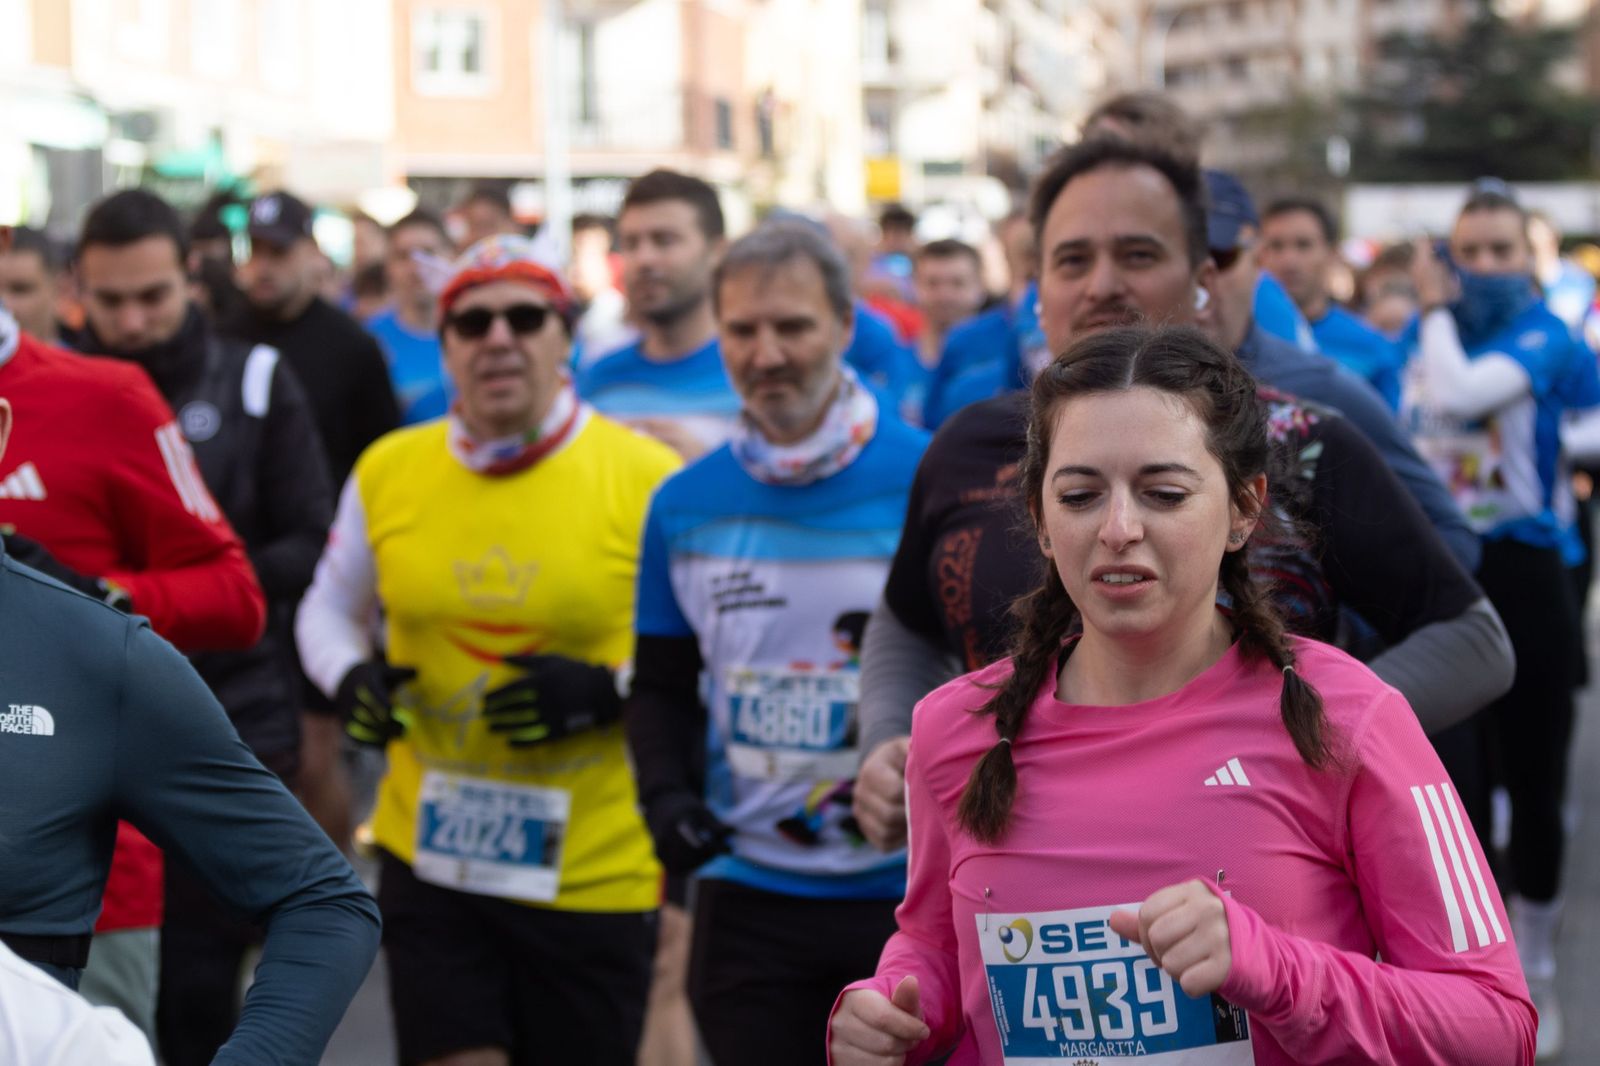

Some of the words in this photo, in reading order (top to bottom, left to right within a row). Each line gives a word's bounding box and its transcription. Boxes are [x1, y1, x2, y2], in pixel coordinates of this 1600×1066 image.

[0, 713, 32, 724] ORTH
[8, 704, 32, 716] THE
[1, 722, 32, 734] FACE
[737, 698, 830, 746] 4860
[431, 804, 527, 860] 2024
[1023, 958, 1178, 1041] 4939
[1059, 1040, 1147, 1057] MARGARITA
